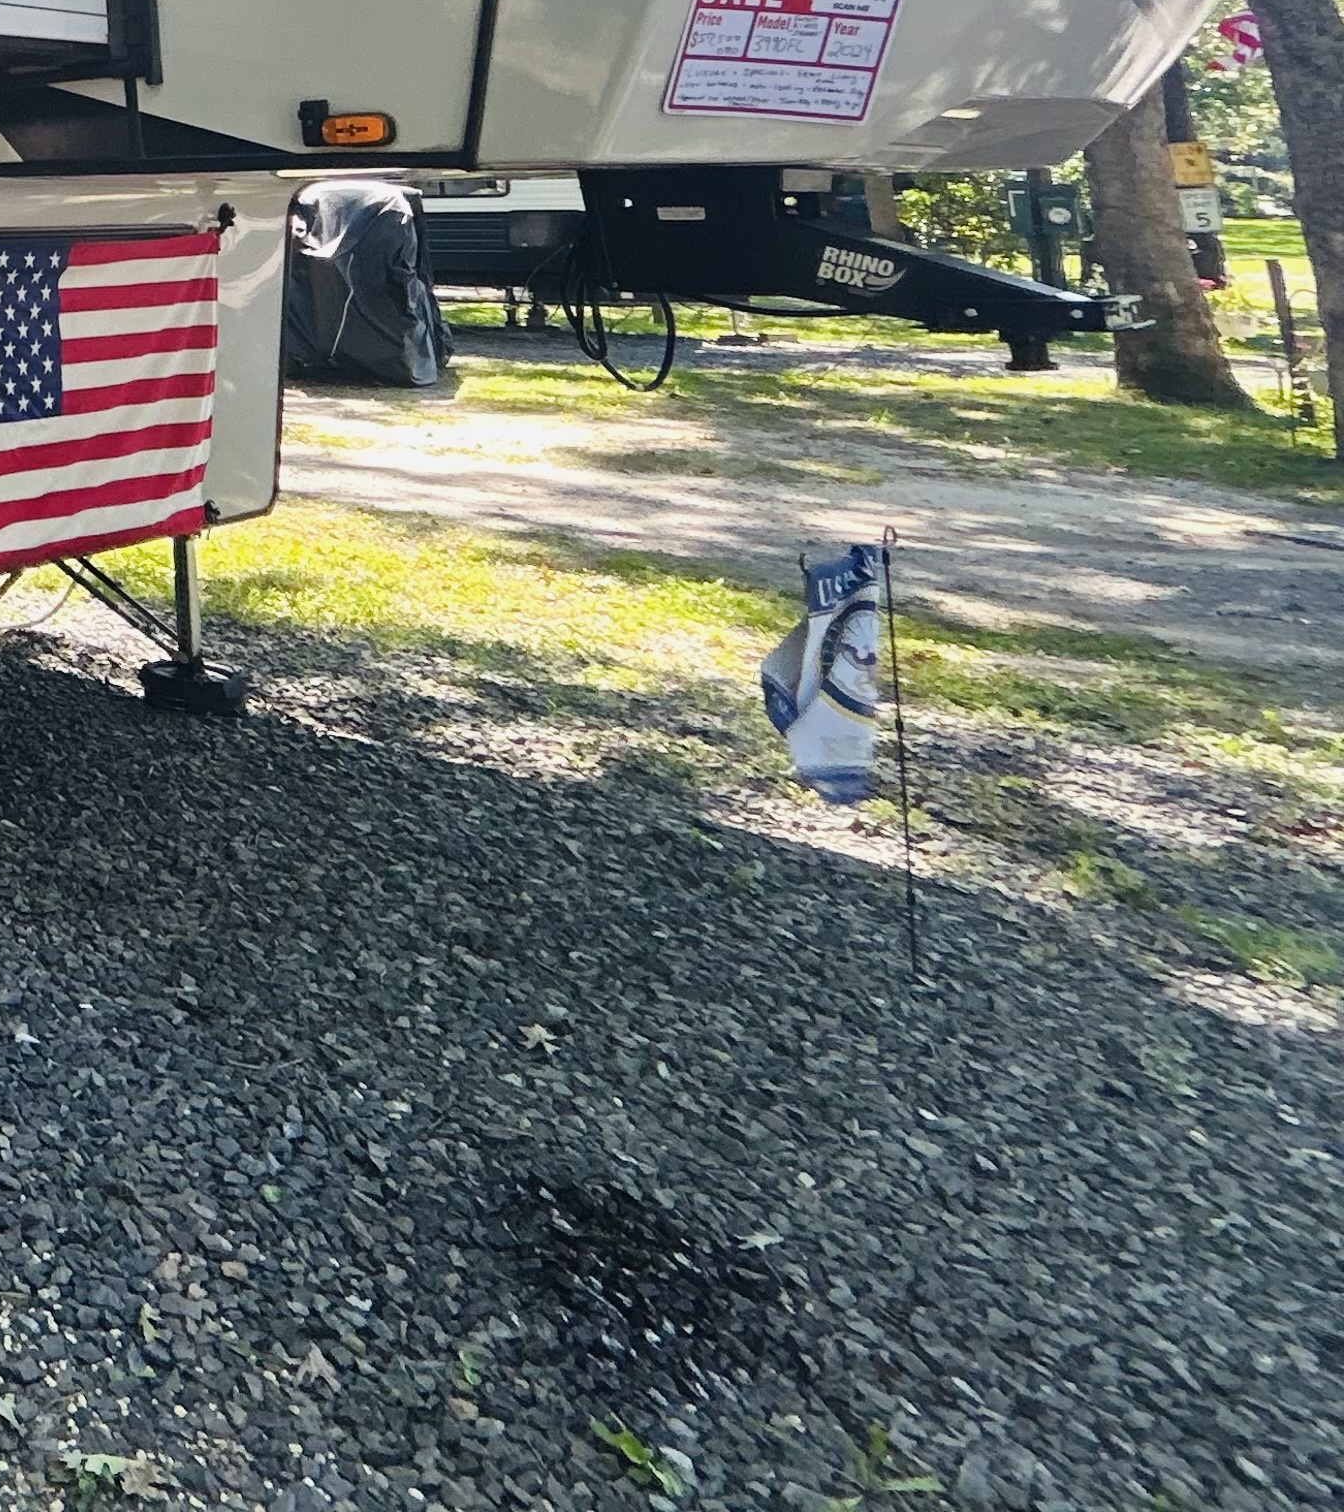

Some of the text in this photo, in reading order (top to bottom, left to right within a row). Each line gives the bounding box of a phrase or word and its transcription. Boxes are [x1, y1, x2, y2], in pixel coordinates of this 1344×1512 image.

[696, 11, 723, 27] Price
[756, 15, 792, 30] Model
[834, 21, 863, 36] Year
[827, 41, 874, 64] 2024
[1196, 212, 1212, 228] 5
[823, 246, 894, 276] RHINO
[817, 262, 867, 288] BOX
